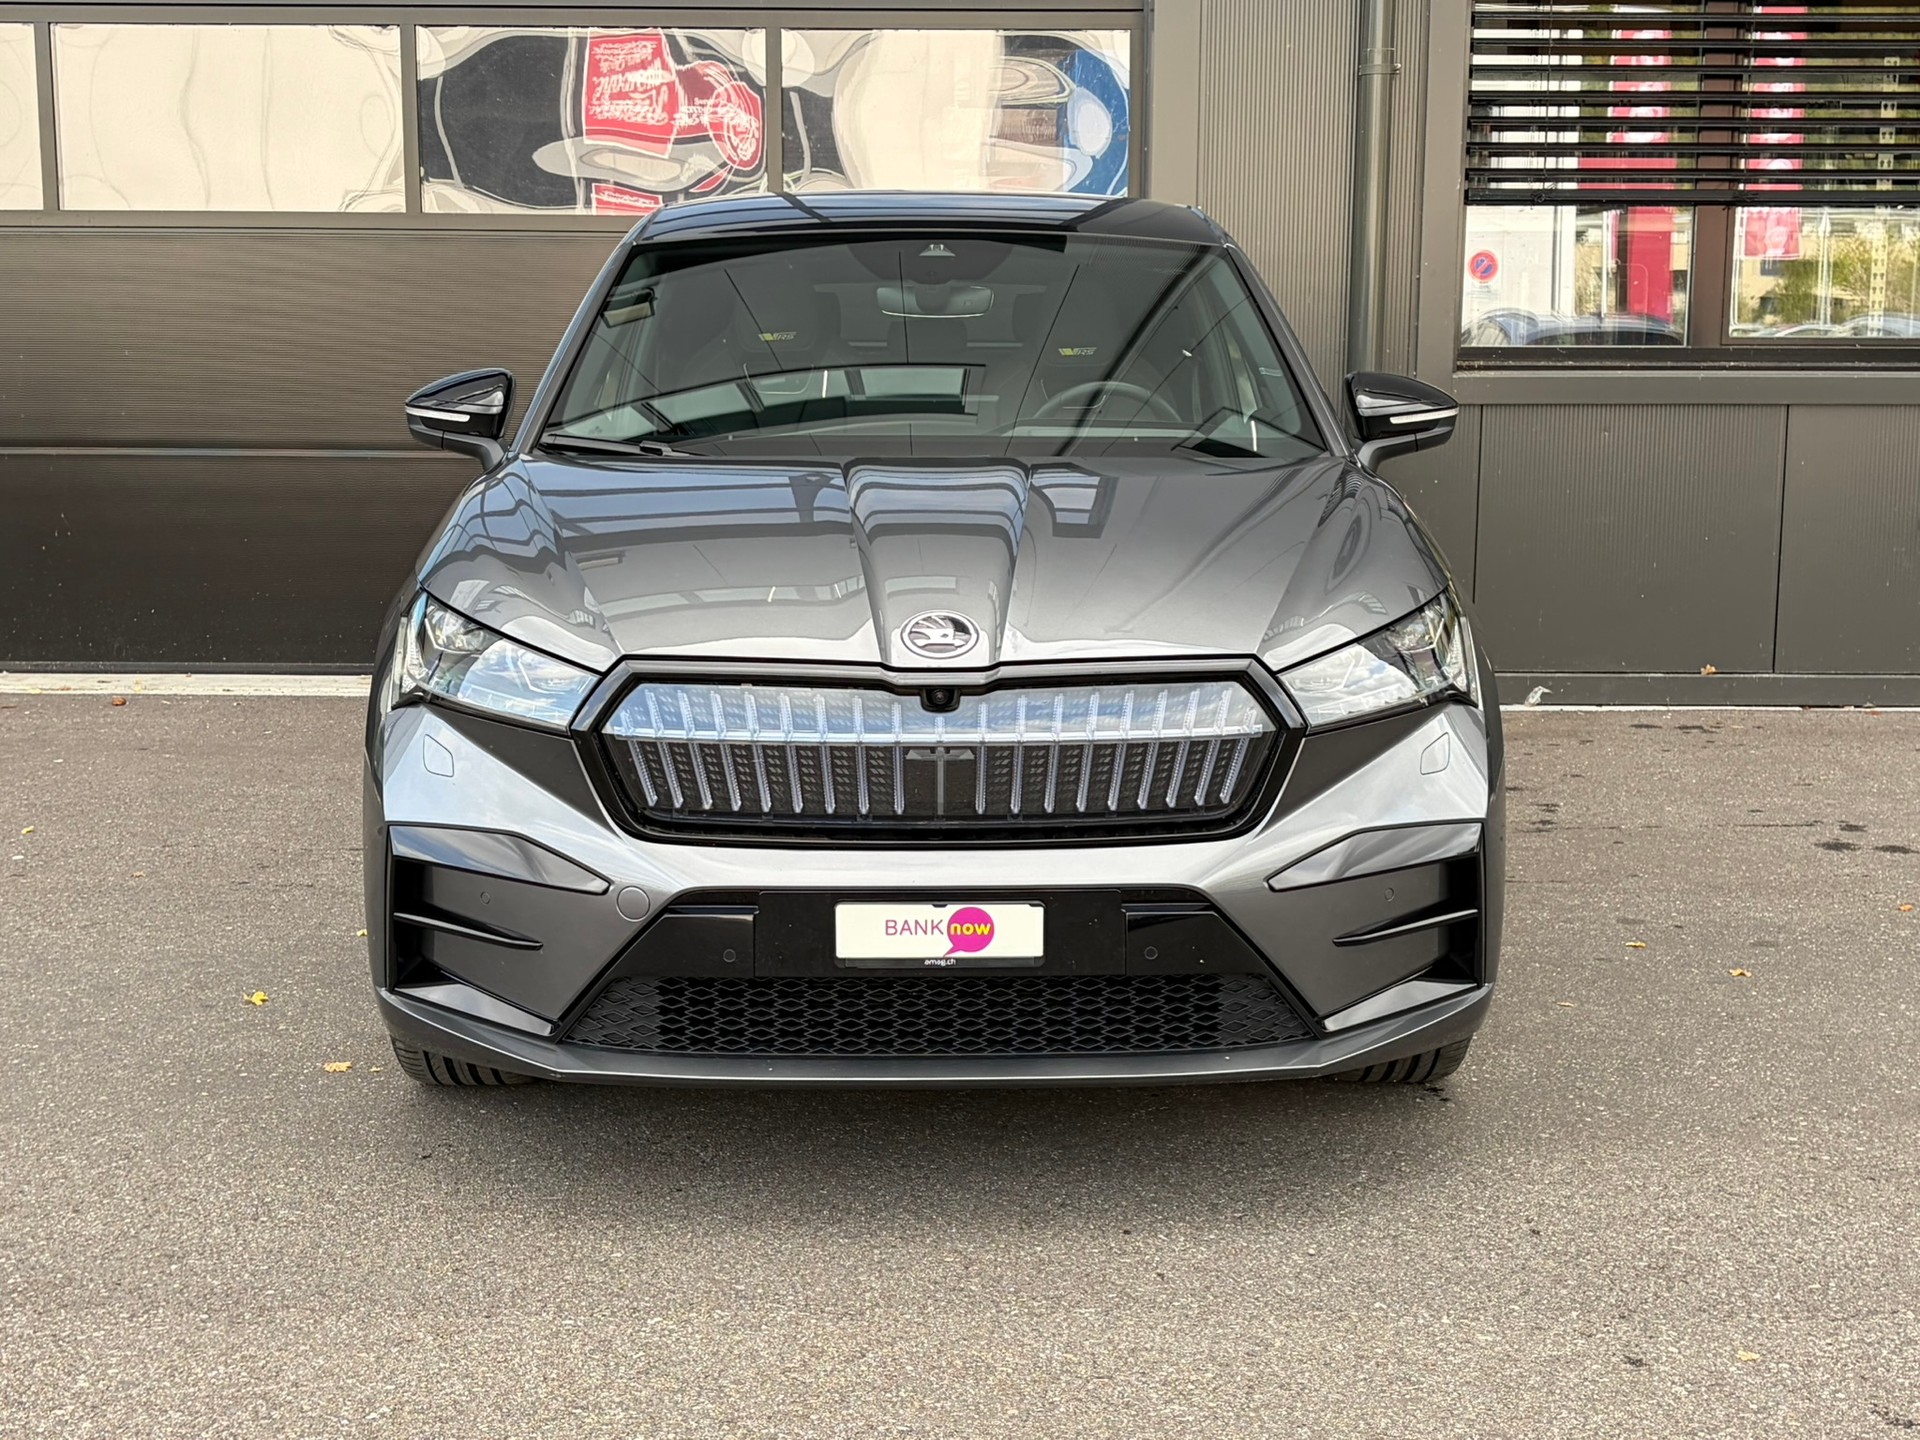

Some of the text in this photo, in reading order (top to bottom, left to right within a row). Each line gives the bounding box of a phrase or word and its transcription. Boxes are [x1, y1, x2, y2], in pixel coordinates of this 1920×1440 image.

[884, 919, 991, 936] BANK now
[923, 957, 956, 967] amag.ch
